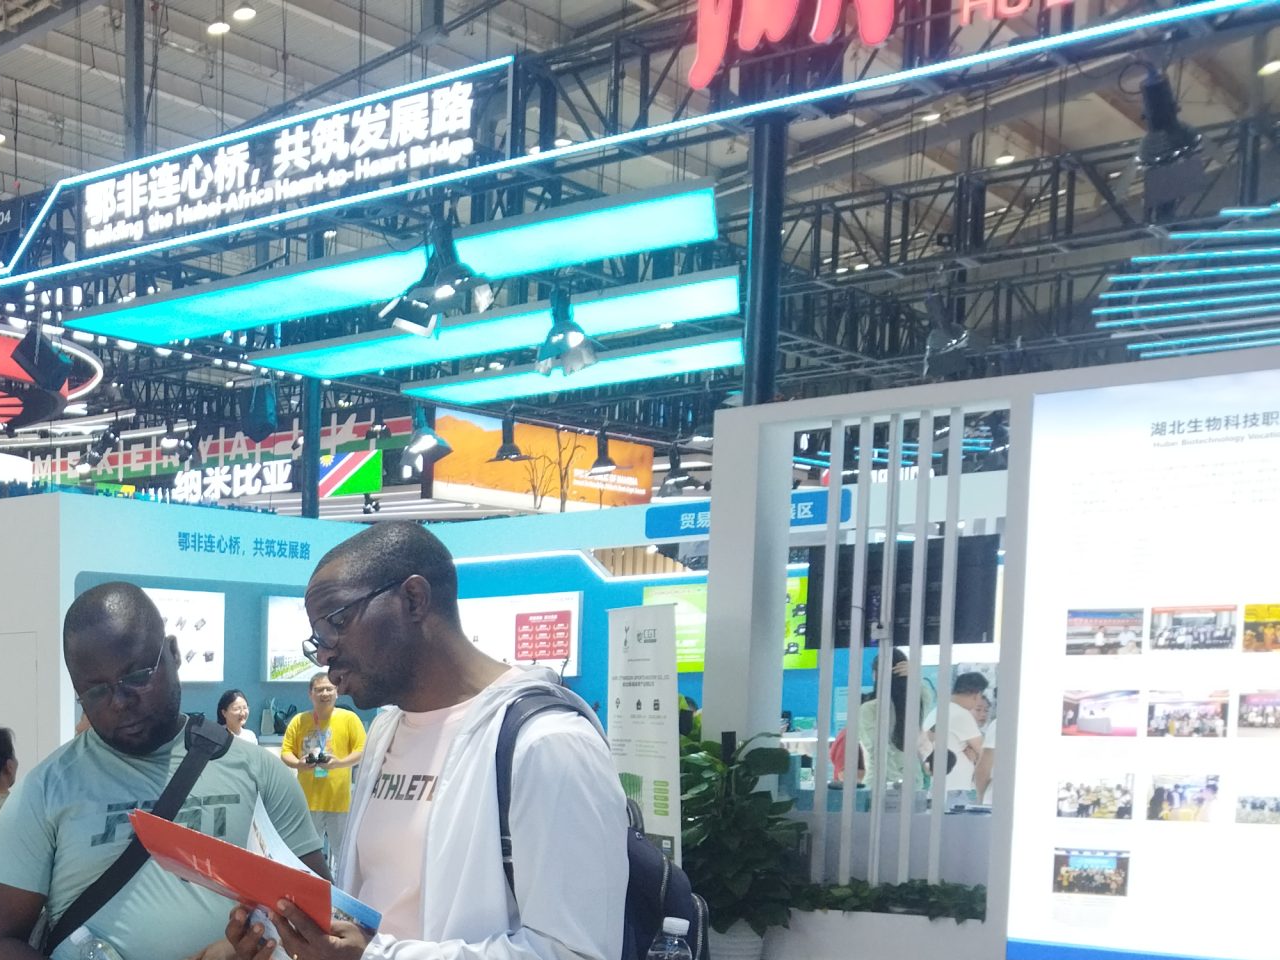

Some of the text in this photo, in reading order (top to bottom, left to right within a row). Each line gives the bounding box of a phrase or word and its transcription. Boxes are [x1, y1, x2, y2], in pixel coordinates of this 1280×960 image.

[148, 211, 174, 233] the
[174, 459, 293, 502] 纳米比亚
[178, 532, 311, 561] 鄂非连心桥，共筑发展路
